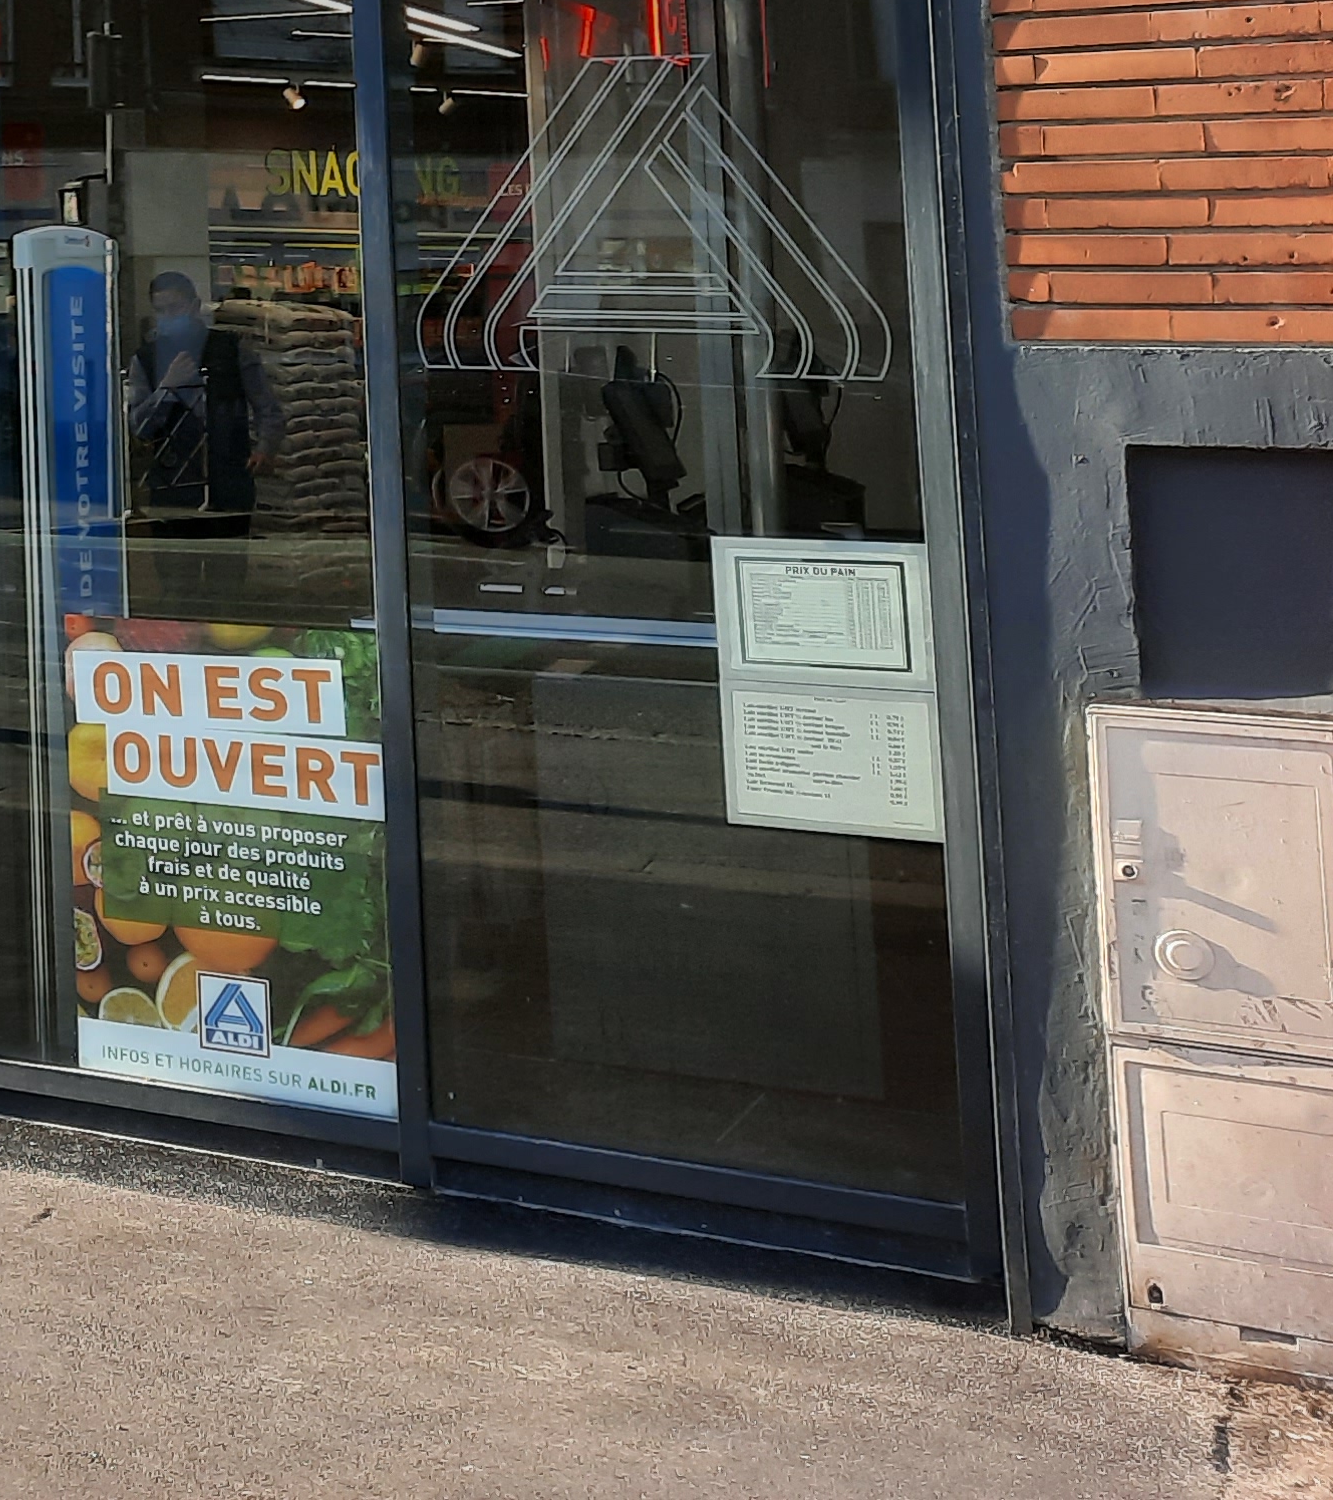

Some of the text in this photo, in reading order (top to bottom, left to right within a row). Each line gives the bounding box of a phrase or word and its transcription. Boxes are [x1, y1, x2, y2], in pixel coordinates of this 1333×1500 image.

[70, 295, 93, 599] DE VOTRE VISITE
[785, 566, 856, 577] PRIX DU PAIN
[92, 661, 332, 725] ON EST
[112, 731, 381, 807] OUVERT
[132, 811, 151, 827] et
[154, 812, 193, 831] prêt
[196, 814, 208, 833] à
[212, 821, 256, 837] vous
[261, 824, 348, 848] proposer
[114, 830, 346, 871] chaque jour des produits
[147, 856, 312, 891] frais et de qualité
[139, 875, 323, 915] à un prix accessible
[199, 906, 262, 931] à tous.
[211, 1031, 260, 1049] ALDI
[101, 1044, 377, 1100] INFOS ET HORAIRES SUR ALDI.FR
